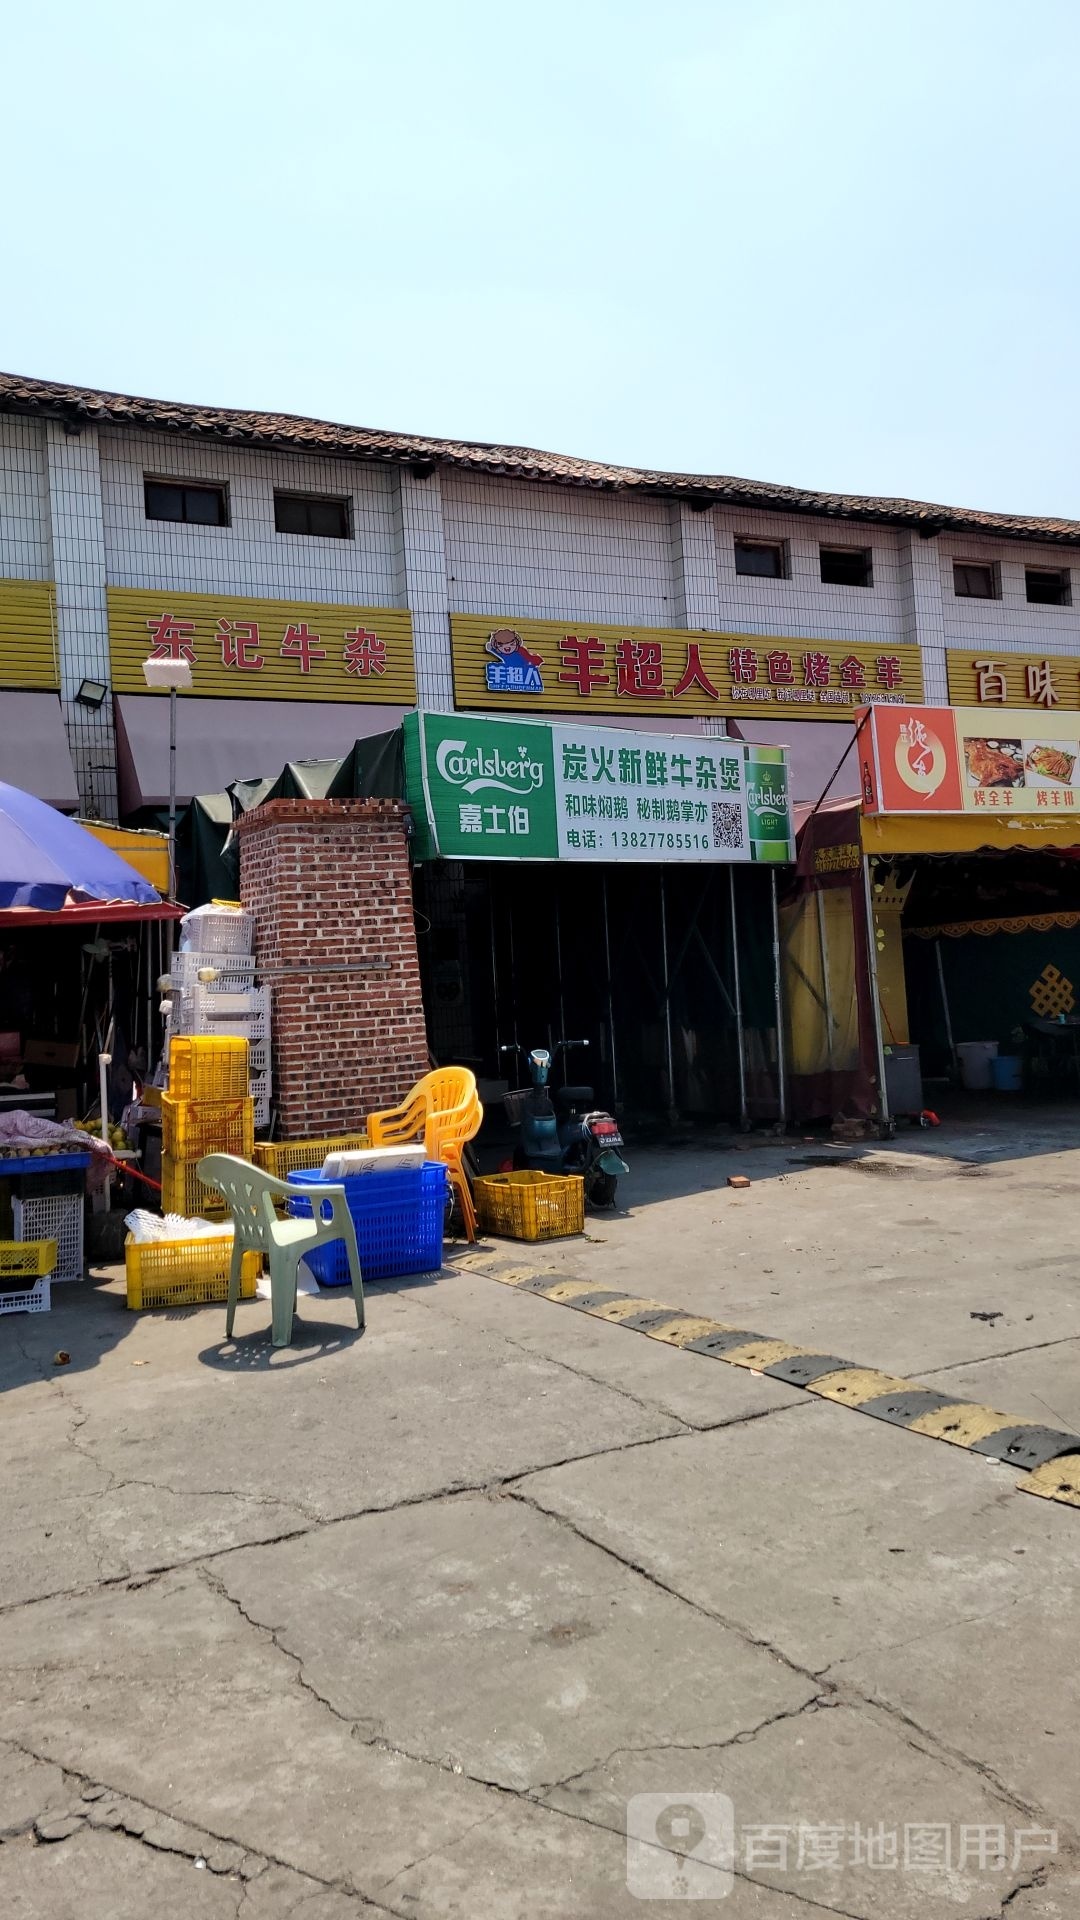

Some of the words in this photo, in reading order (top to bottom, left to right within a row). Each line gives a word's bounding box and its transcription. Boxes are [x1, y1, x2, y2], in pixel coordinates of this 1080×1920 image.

[146, 613, 388, 677] 东记牛杂
[489, 666, 541, 686] 羊超人
[558, 635, 720, 701] 羊超人
[729, 647, 904, 690] 特色烤全羊
[972, 660, 1080, 708] 百味
[436, 739, 545, 793] Carlsberg
[562, 743, 742, 792] 炭火新鲜牛杂煲
[565, 793, 629, 820] 和味焖鹅
[636, 797, 708, 823] 秘制鹅掌亦
[974, 790, 1014, 806] 烤全羊
[1036, 790, 1074, 806] 烤羊排
[459, 803, 530, 835] 嘉士伯
[761, 818, 778, 826] LIGHT
